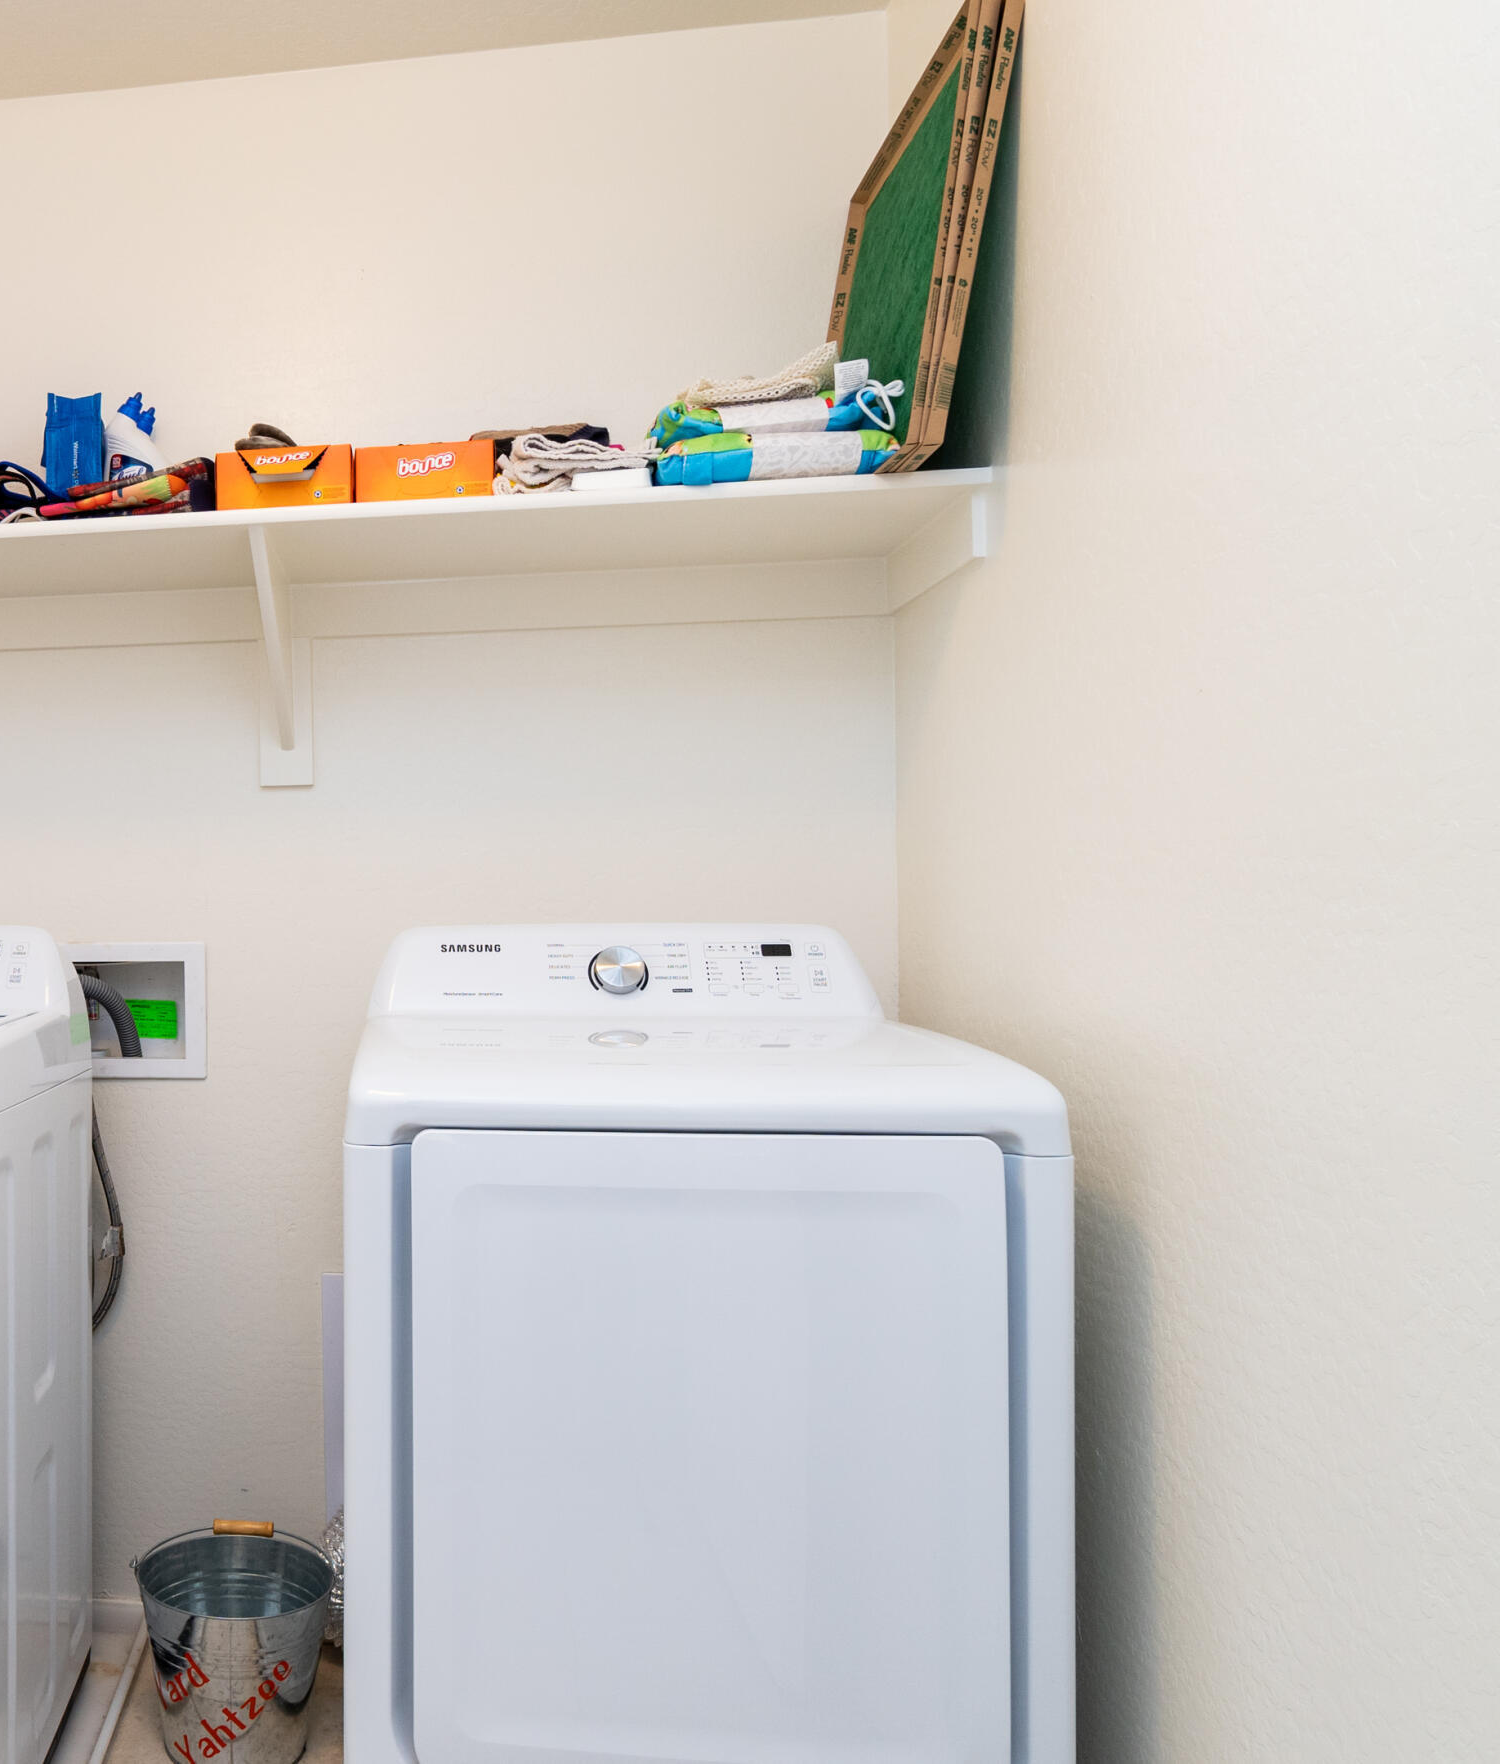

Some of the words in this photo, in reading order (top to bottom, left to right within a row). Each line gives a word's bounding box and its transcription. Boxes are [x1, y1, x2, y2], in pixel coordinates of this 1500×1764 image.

[1003, 26, 1015, 53] AAF
[969, 115, 980, 136] EZ
[986, 117, 998, 140] EZ
[835, 292, 847, 309] EZ
[254, 450, 312, 466] bounce
[397, 452, 455, 477] bounce
[440, 944, 501, 953] SAMSUNG
[173, 1660, 293, 1764] Yahtzee
